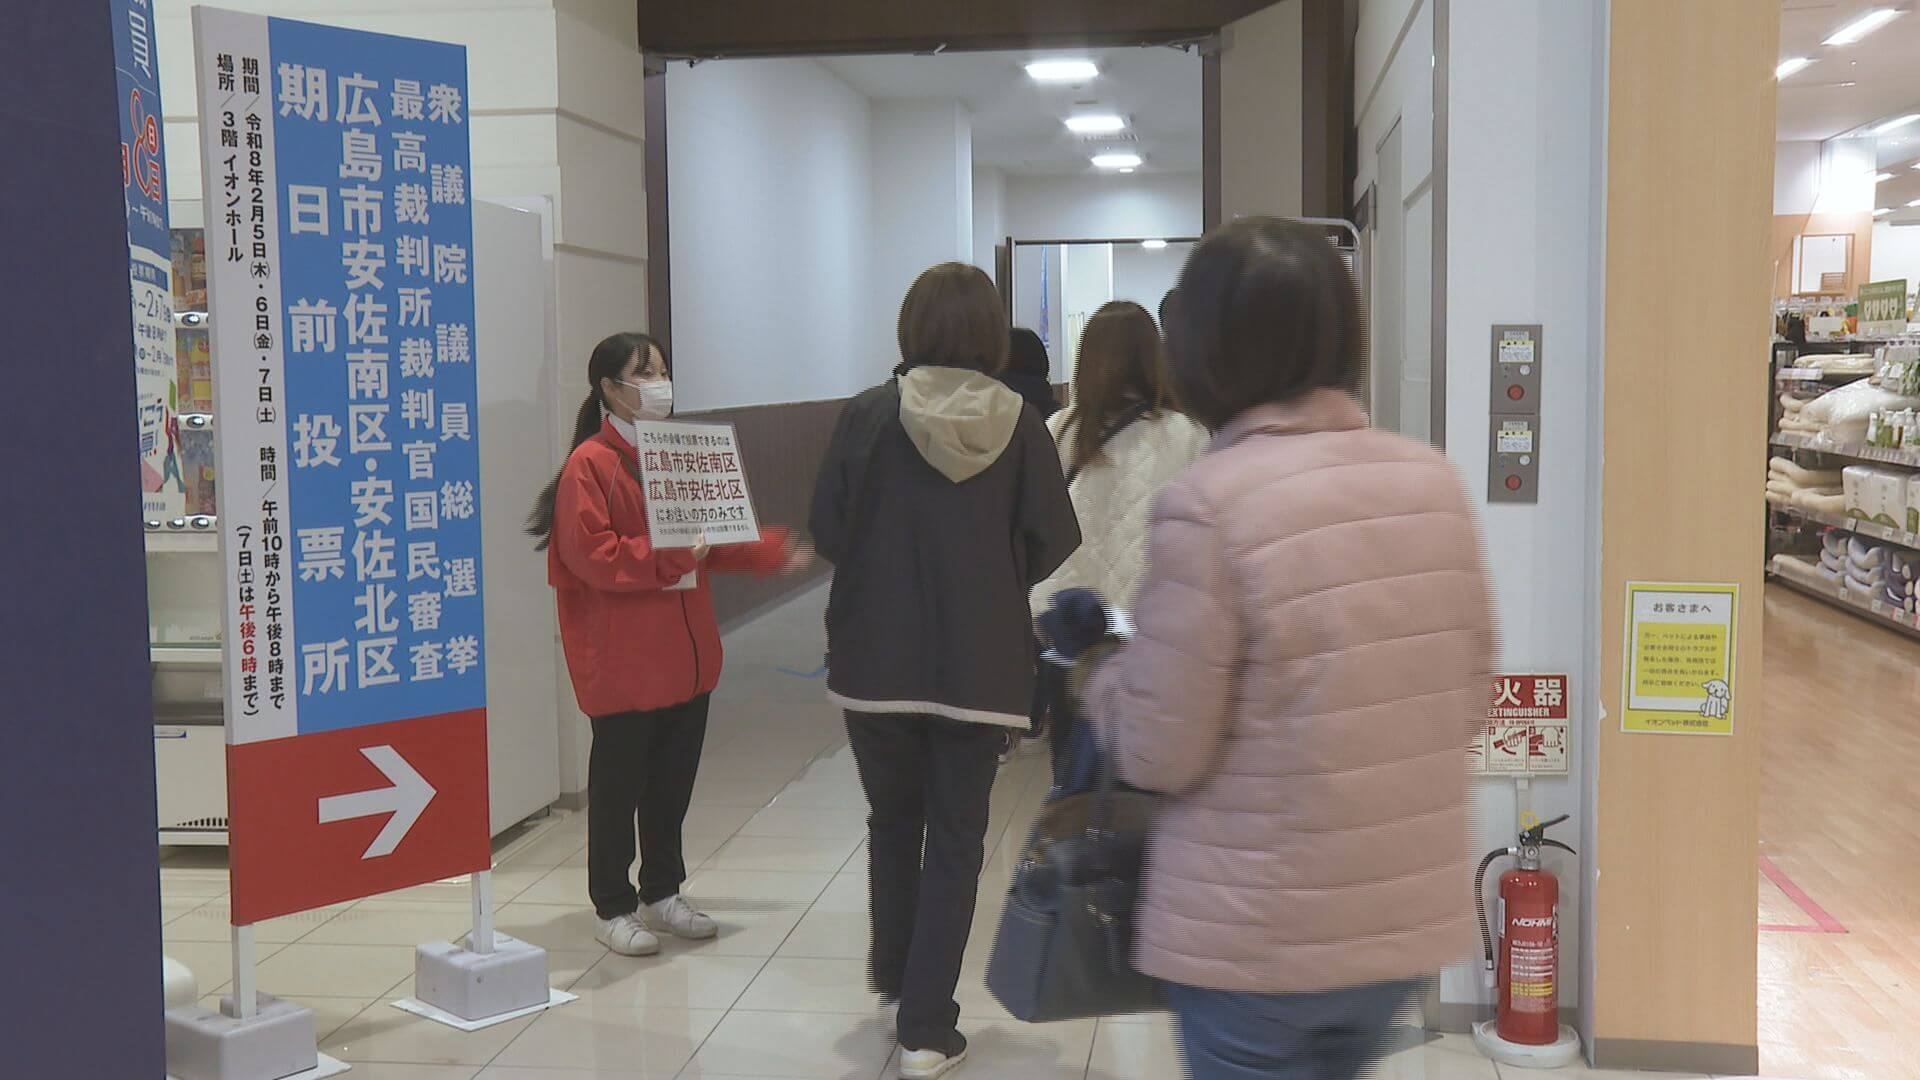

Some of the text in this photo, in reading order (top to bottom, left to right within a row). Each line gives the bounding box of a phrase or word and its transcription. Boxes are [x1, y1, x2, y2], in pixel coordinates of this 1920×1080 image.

[223, 154, 243, 263] イオンホール
[278, 62, 350, 695] 期日前投票所
[336, 72, 400, 688] 広島市安佐南区・安佐北区
[390, 79, 443, 681] 最高裁判所裁判官国民審査
[427, 83, 478, 674] 衆議院議員総選挙
[644, 449, 738, 473] 広島市安佐南区
[648, 478, 745, 501] 広島市安佐北区
[656, 506, 745, 522] にお住いの方のみです
[1653, 602, 1712, 613] お客さまへ
